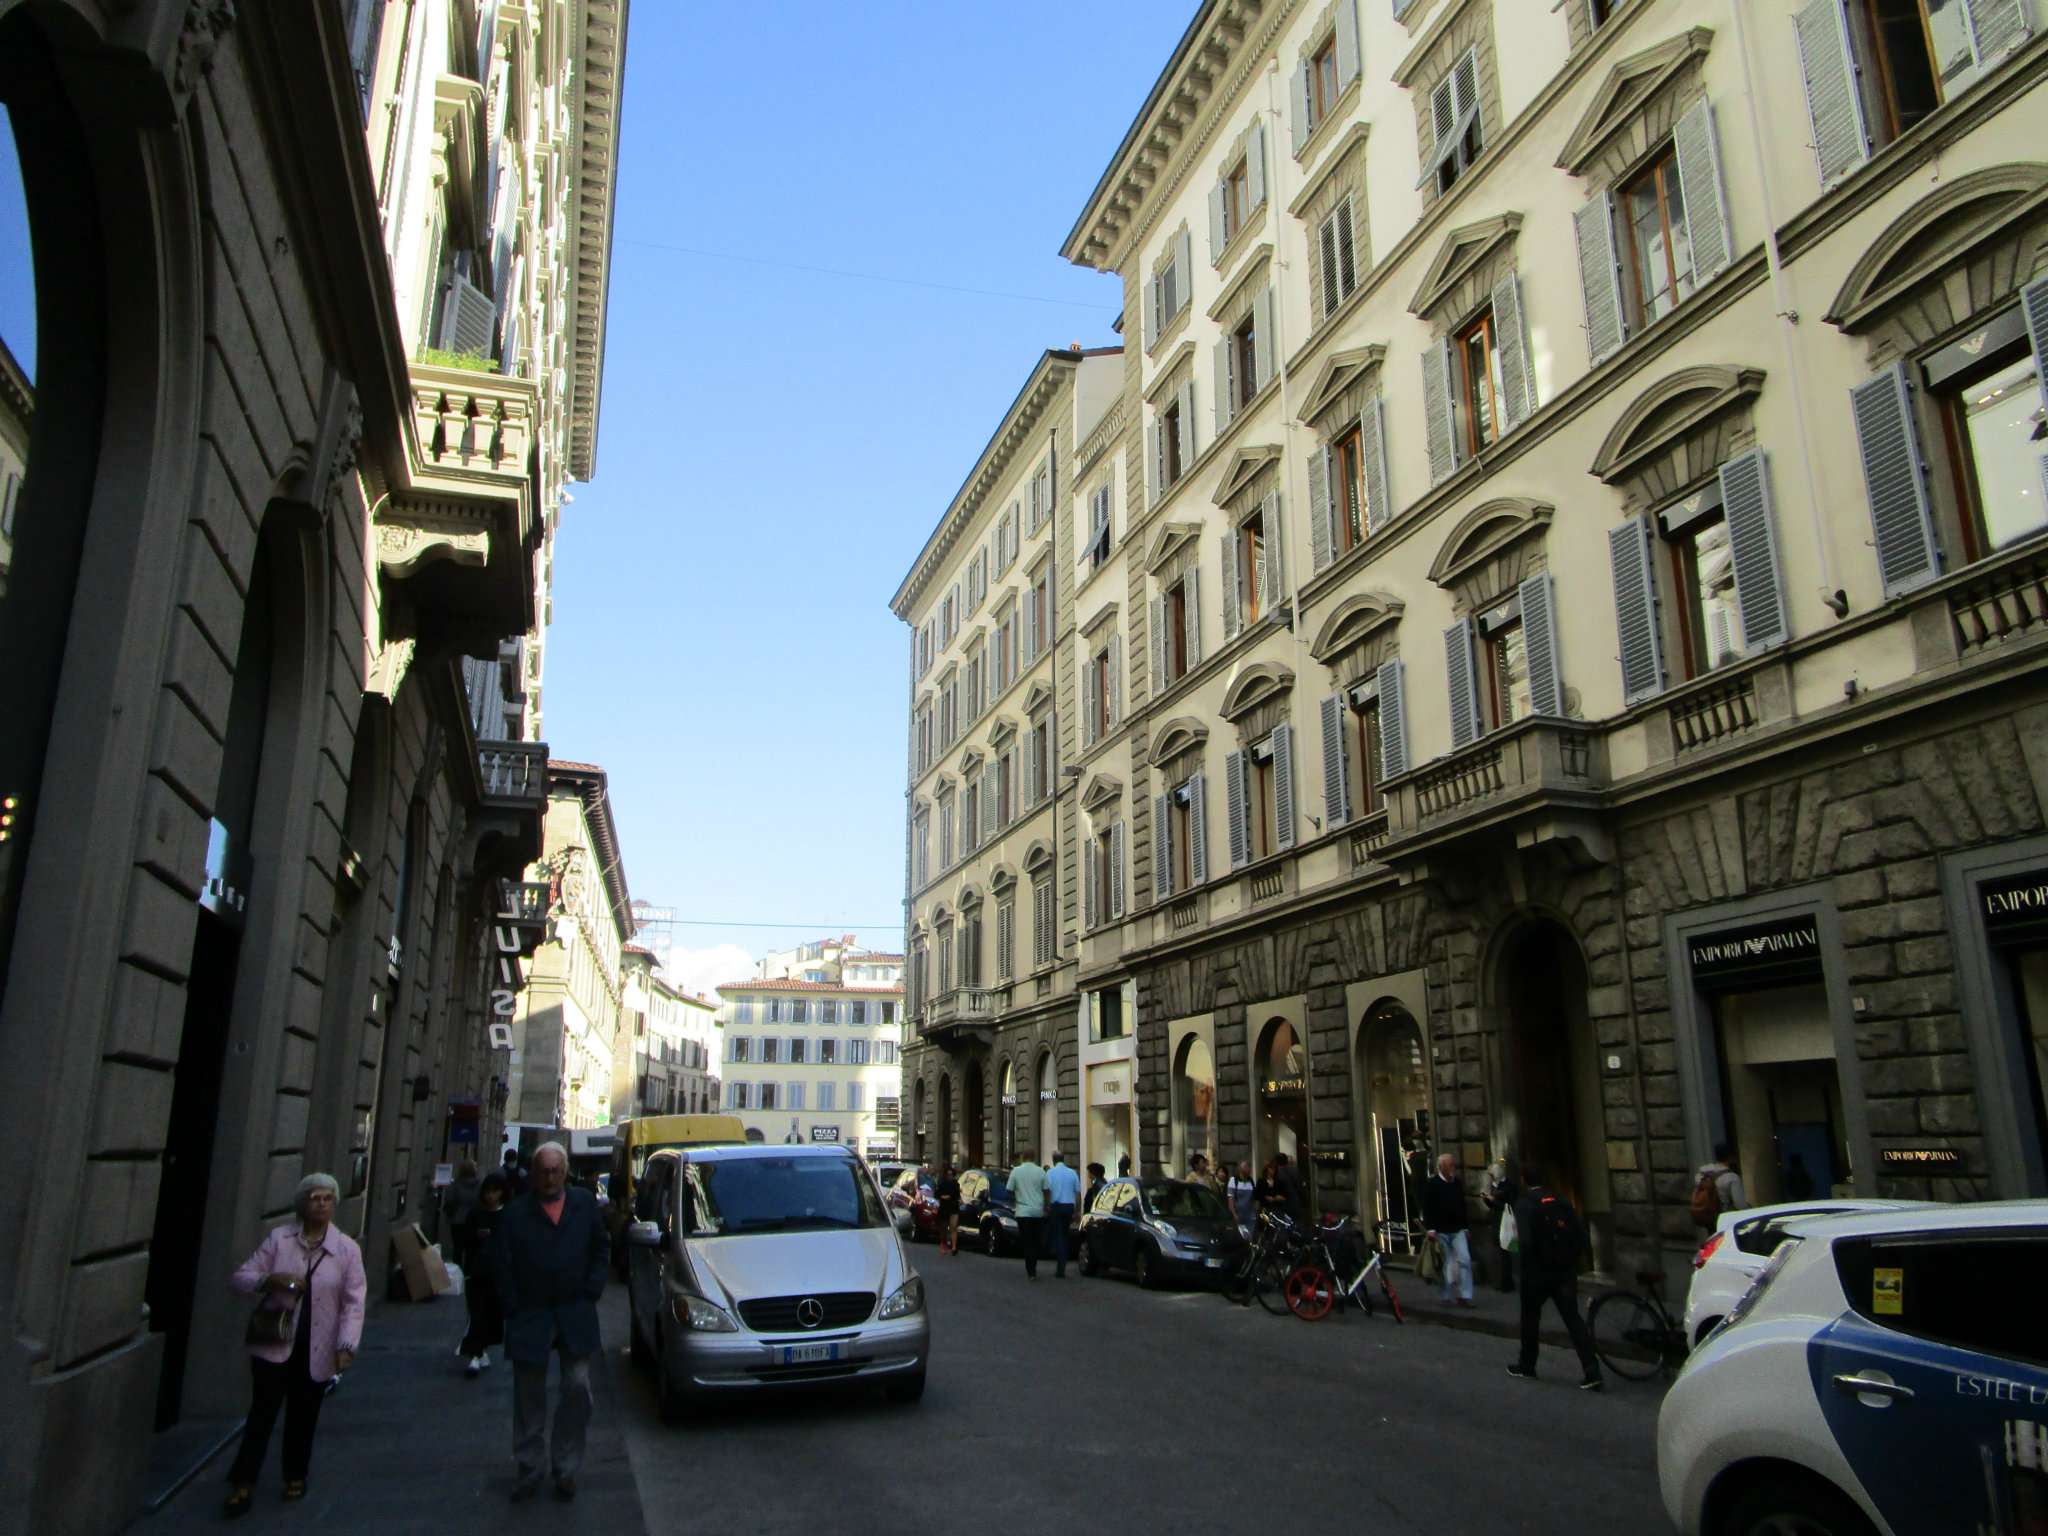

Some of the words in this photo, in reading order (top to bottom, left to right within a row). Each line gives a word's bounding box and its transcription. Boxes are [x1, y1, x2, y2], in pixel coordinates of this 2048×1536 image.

[1692, 942, 1742, 965] EMPORIO
[1765, 928, 1816, 952] ARMANI
[1001, 1095, 1017, 1105] PINKO
[1040, 1089, 1057, 1100] PINKO
